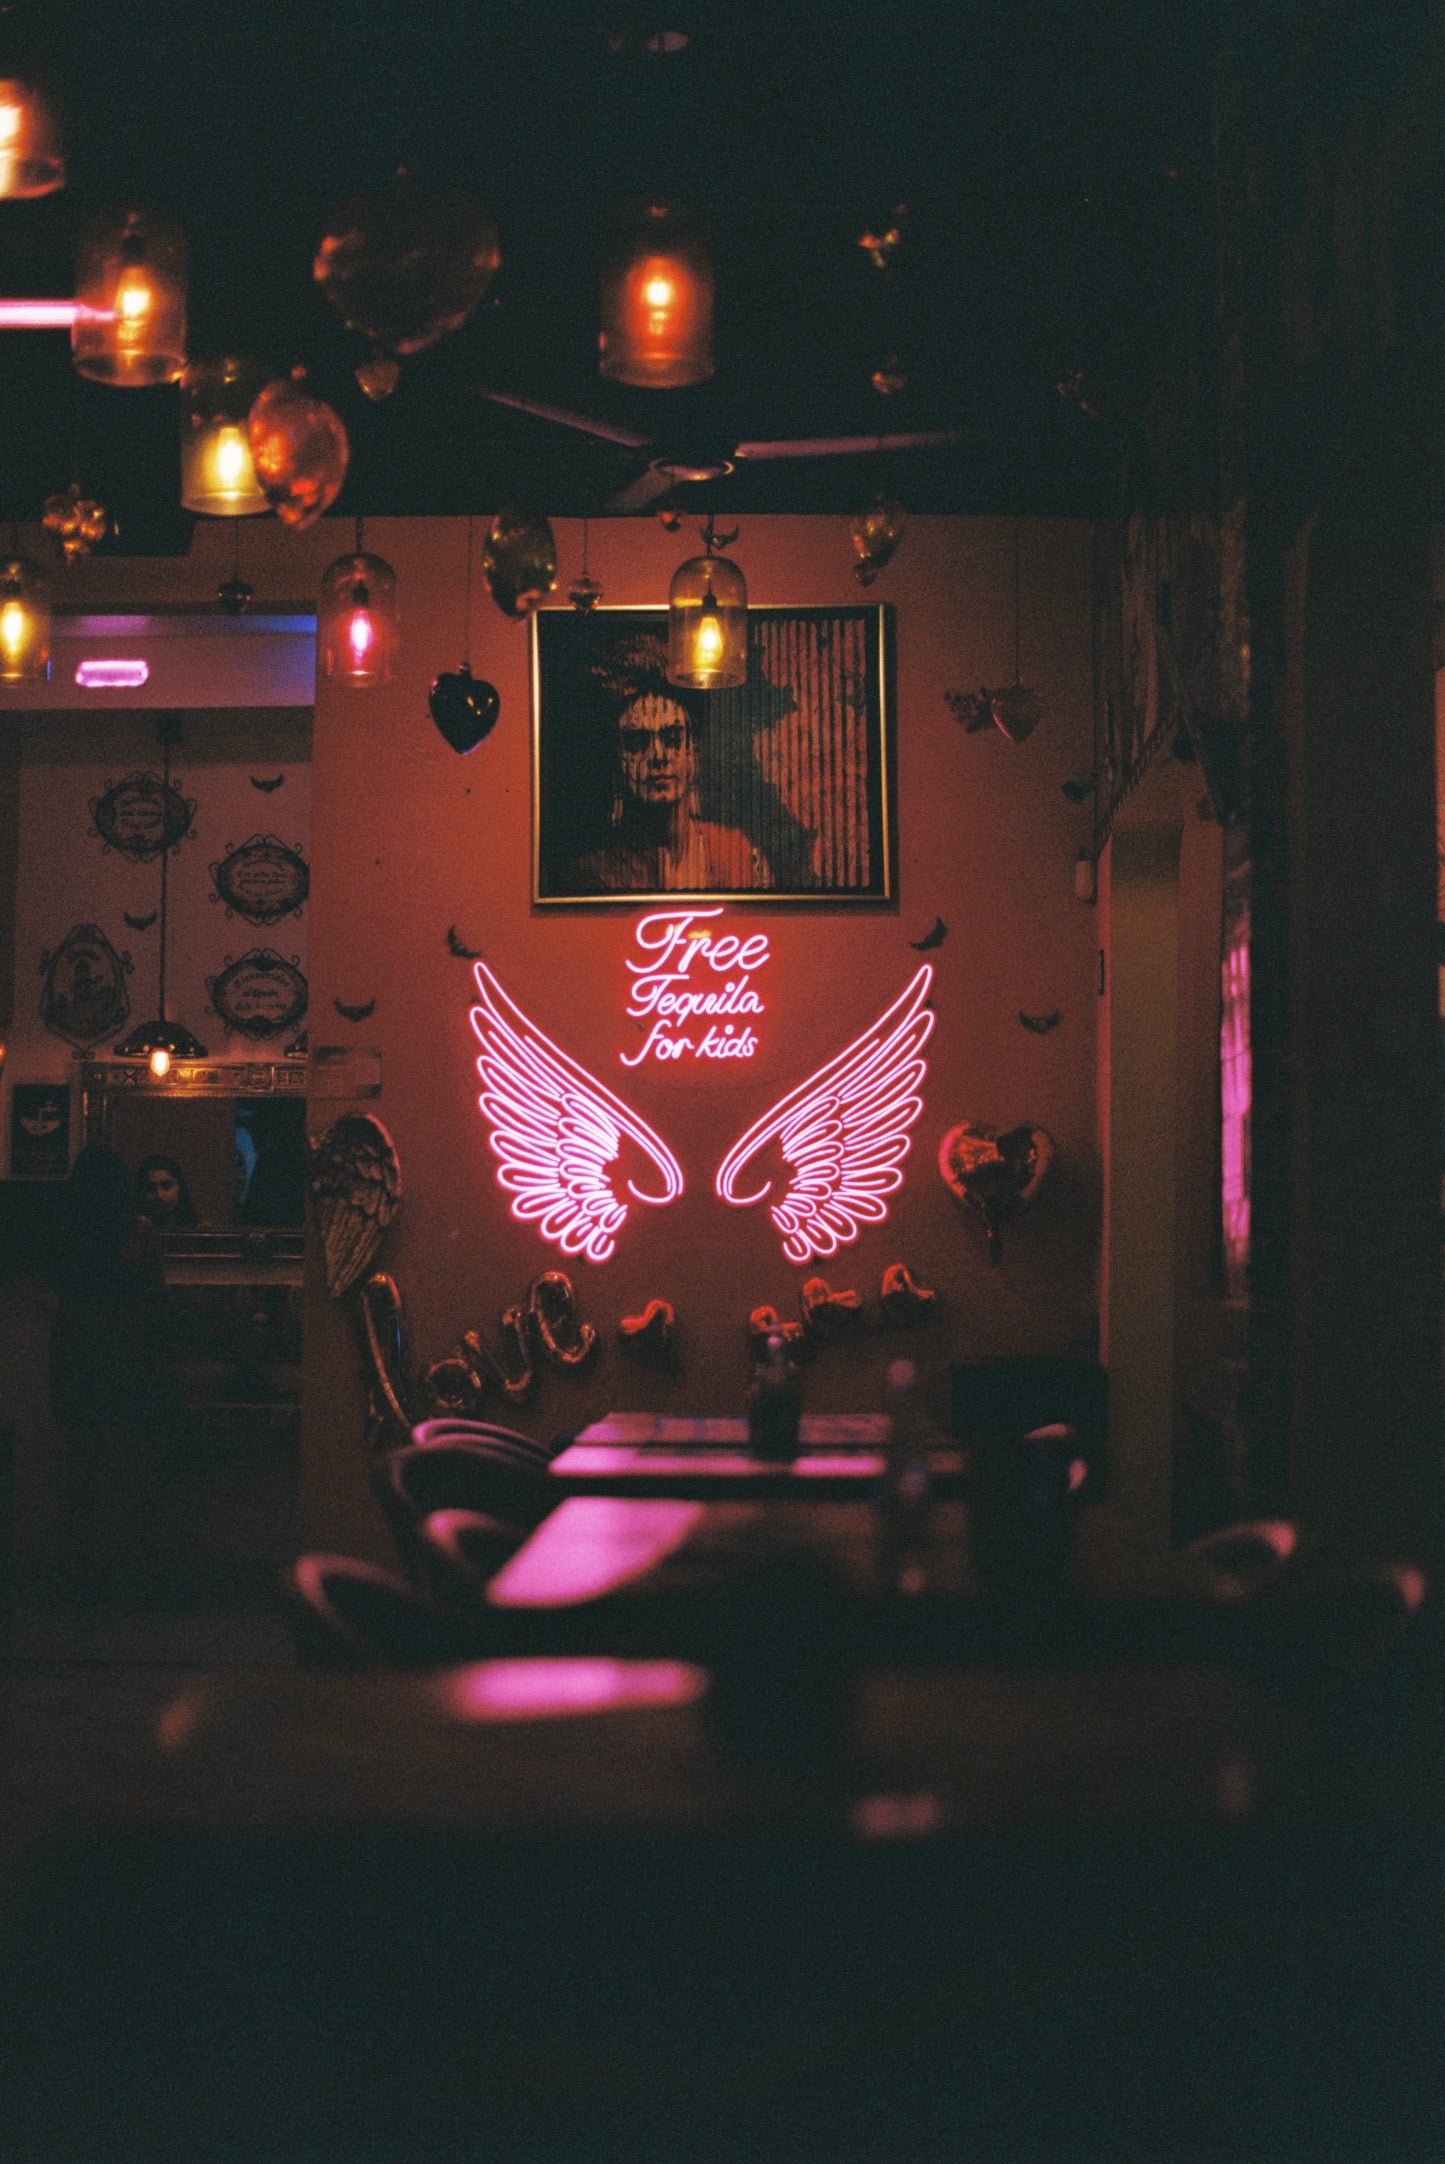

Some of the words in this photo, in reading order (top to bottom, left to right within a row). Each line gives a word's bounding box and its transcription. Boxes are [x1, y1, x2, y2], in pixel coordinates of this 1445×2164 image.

[625, 907, 771, 973] Free
[626, 974, 765, 1027] Tequila
[620, 1019, 695, 1066] for
[694, 1025, 759, 1059] kids
